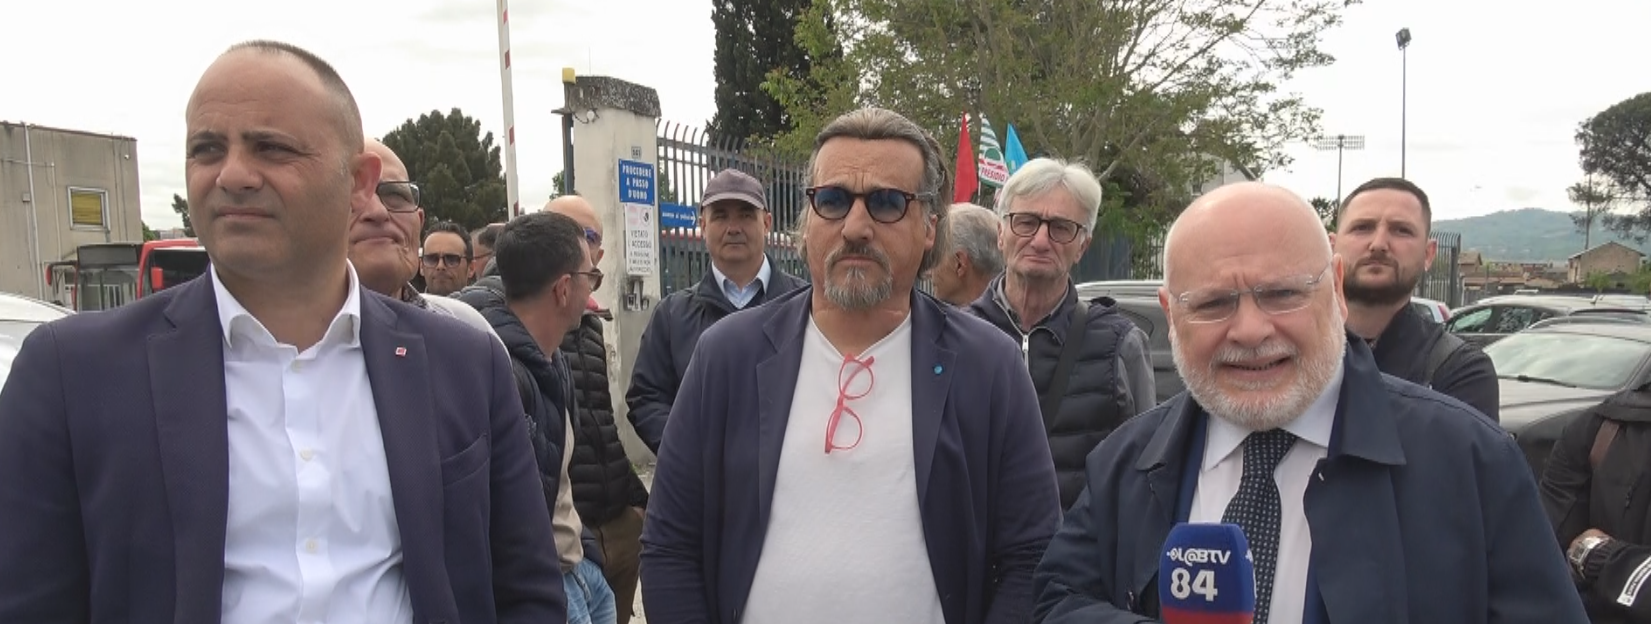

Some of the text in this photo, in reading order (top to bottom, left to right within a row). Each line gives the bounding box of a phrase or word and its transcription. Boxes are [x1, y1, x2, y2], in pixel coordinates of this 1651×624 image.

[622, 165, 652, 178] PROCEDERE
[981, 167, 1005, 181] PRESIDIO
[626, 177, 648, 189] A PASSO
[628, 189, 648, 200] D'UOMO
[1171, 567, 1218, 602] 84
